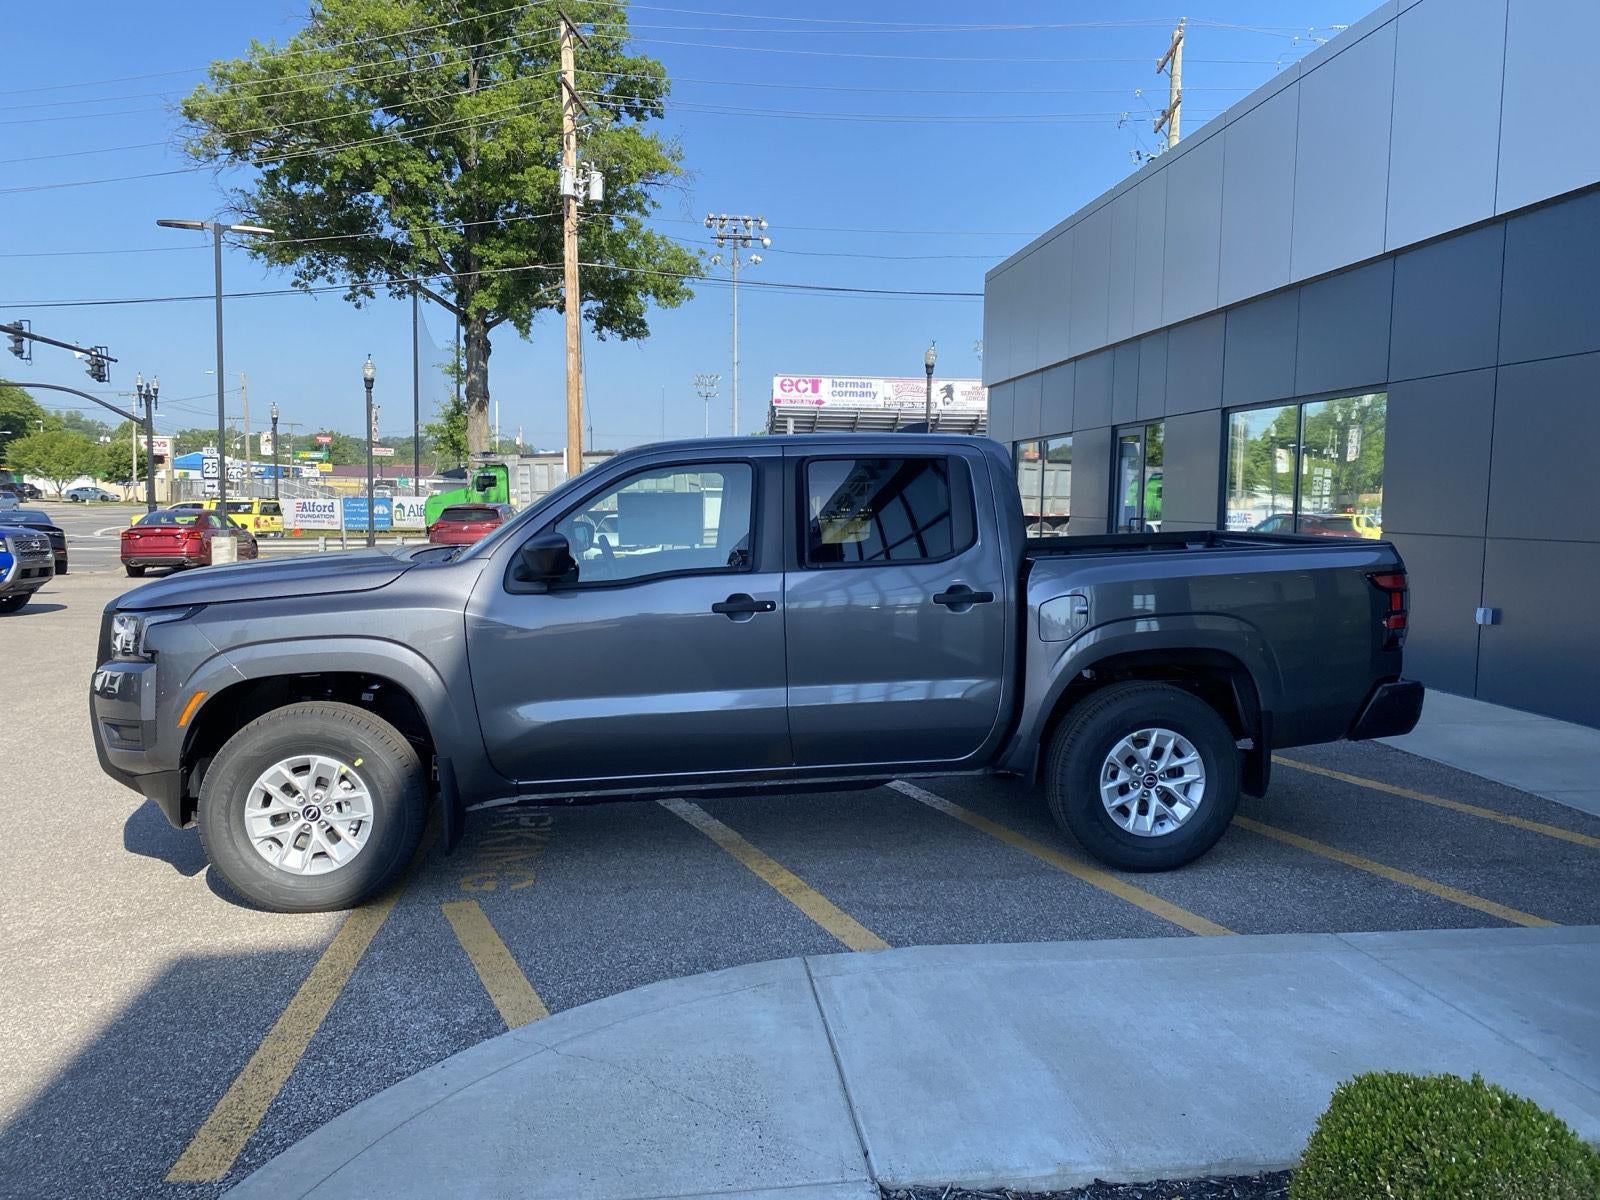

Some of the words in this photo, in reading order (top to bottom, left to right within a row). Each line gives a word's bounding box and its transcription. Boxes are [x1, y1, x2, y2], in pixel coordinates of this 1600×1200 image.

[831, 379, 872, 389] herman
[831, 389, 878, 399] cormany
[204, 462, 218, 473] 25
[229, 470, 242, 479] 60
[301, 501, 335, 512] Alford
[407, 504, 426, 517] Alf
